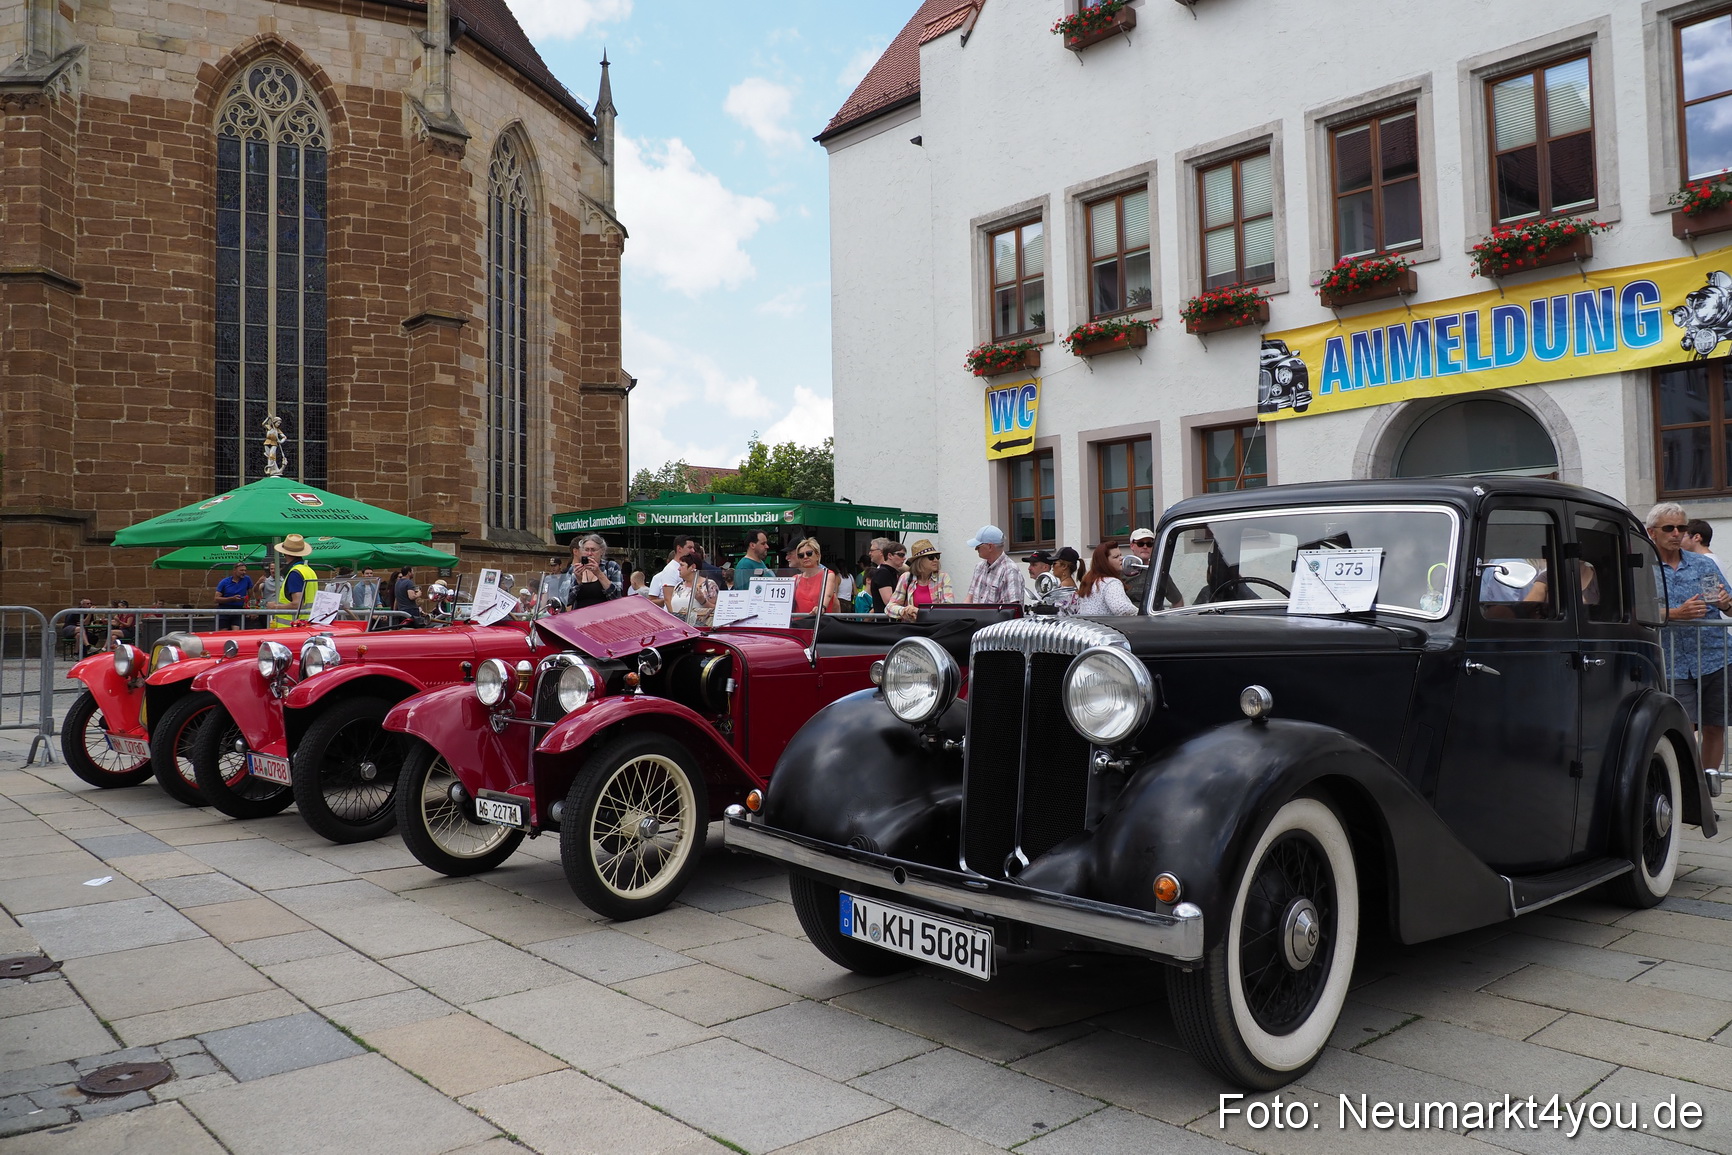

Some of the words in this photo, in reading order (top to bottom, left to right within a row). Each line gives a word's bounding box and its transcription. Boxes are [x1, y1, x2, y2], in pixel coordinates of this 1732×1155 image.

[1319, 279, 1664, 396] ANMELDUNG
[988, 383, 1037, 435] WC
[280, 512, 370, 521] Lammsbräu
[555, 518, 589, 531] Neumarkter
[589, 514, 626, 528] Lammsbräu
[650, 512, 712, 524] Neumarkter
[714, 511, 779, 523] Lammsbräu
[856, 515, 901, 529] Neumarkter
[901, 518, 938, 531] Lammsbrä
[1334, 562, 1363, 576] 375
[770, 587, 786, 599] 119
[253, 757, 264, 775] AA
[267, 760, 288, 781] 0788
[479, 800, 489, 816] AG
[492, 803, 519, 823] 22771
[843, 917, 849, 927] D
[853, 902, 867, 936] N
[882, 911, 914, 950] KH
[921, 922, 987, 972] 508H
